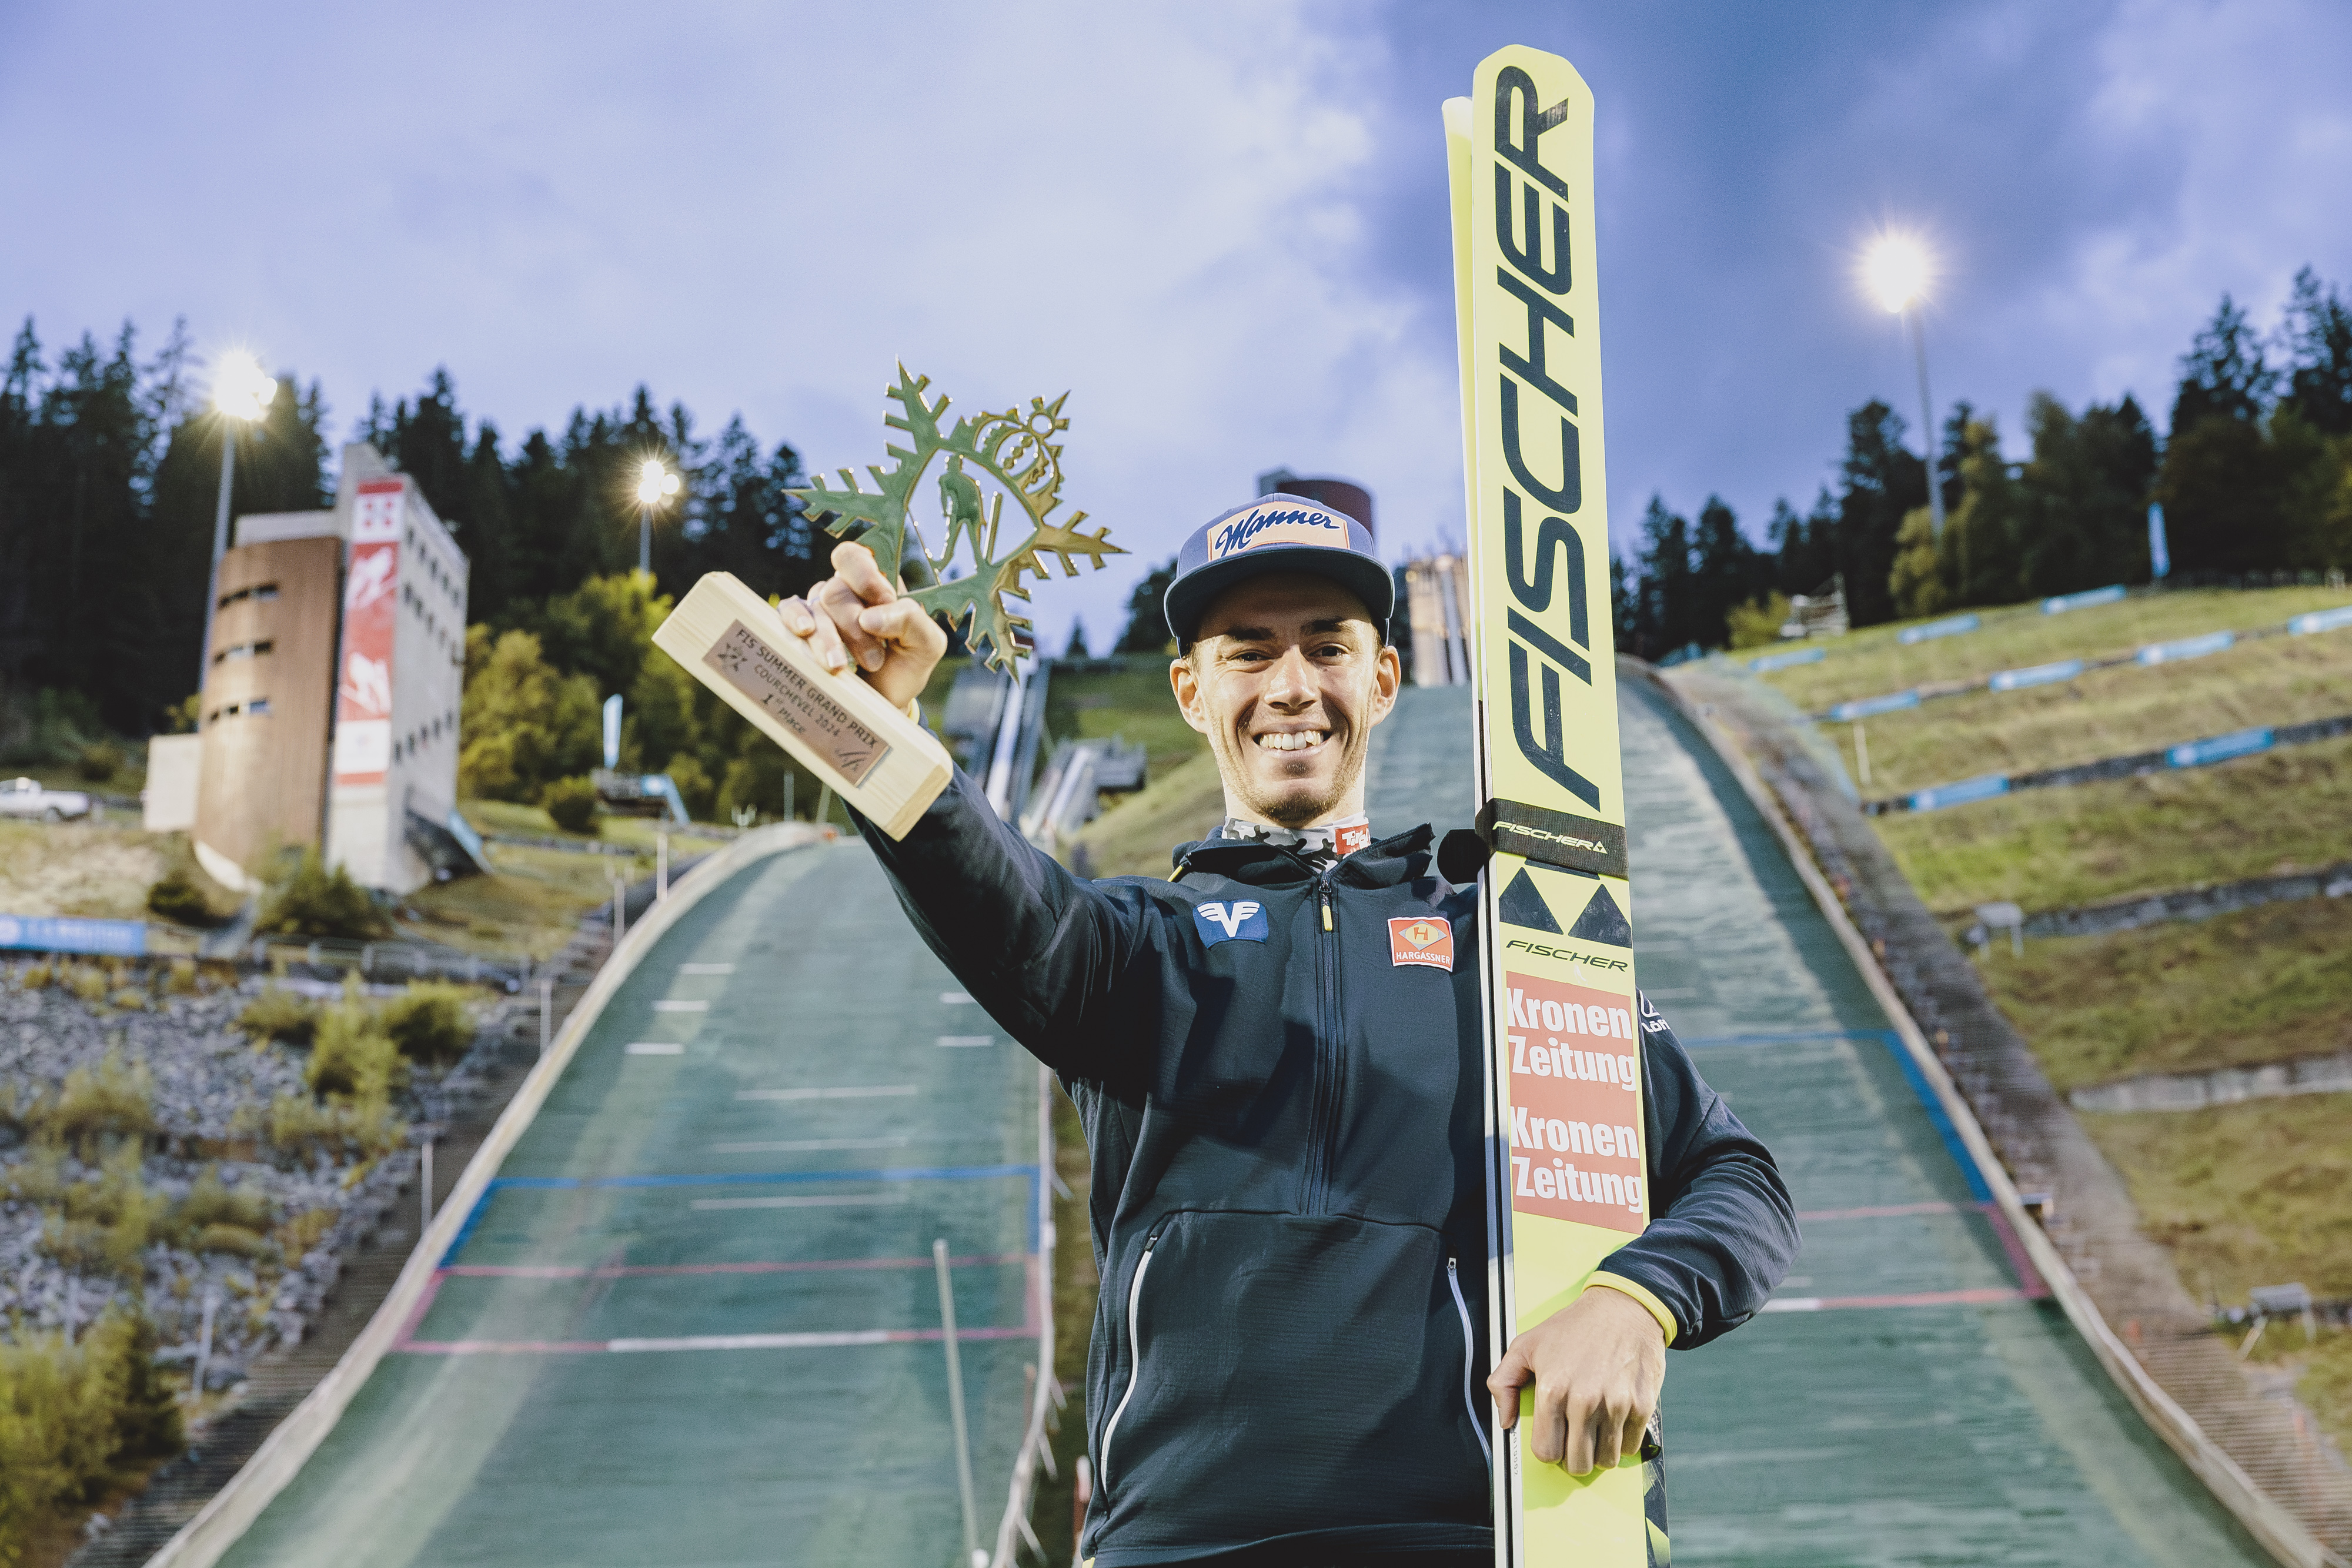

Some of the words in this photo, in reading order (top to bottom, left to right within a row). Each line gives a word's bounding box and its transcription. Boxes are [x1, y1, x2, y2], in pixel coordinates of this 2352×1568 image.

[1494, 65, 1601, 813] FISCHER
[1214, 507, 1341, 557] Manner
[736, 629, 758, 649] FIS
[757, 646, 807, 690] SUMMER
[807, 687, 847, 724] GRAND
[847, 721, 878, 749] PRIX
[754, 664, 814, 717] COURCHEVEL
[815, 713, 841, 737] 2024
[1492, 821, 1595, 852] FISCHER
[1396, 951, 1451, 965] HARGASSNER
[1505, 940, 1628, 972] FISCHER
[1506, 987, 1633, 1039] Kronen
[1508, 1035, 1636, 1092] Zeitung
[1510, 1106, 1640, 1159] Kronen
[1511, 1156, 1643, 1213] Zeitung
